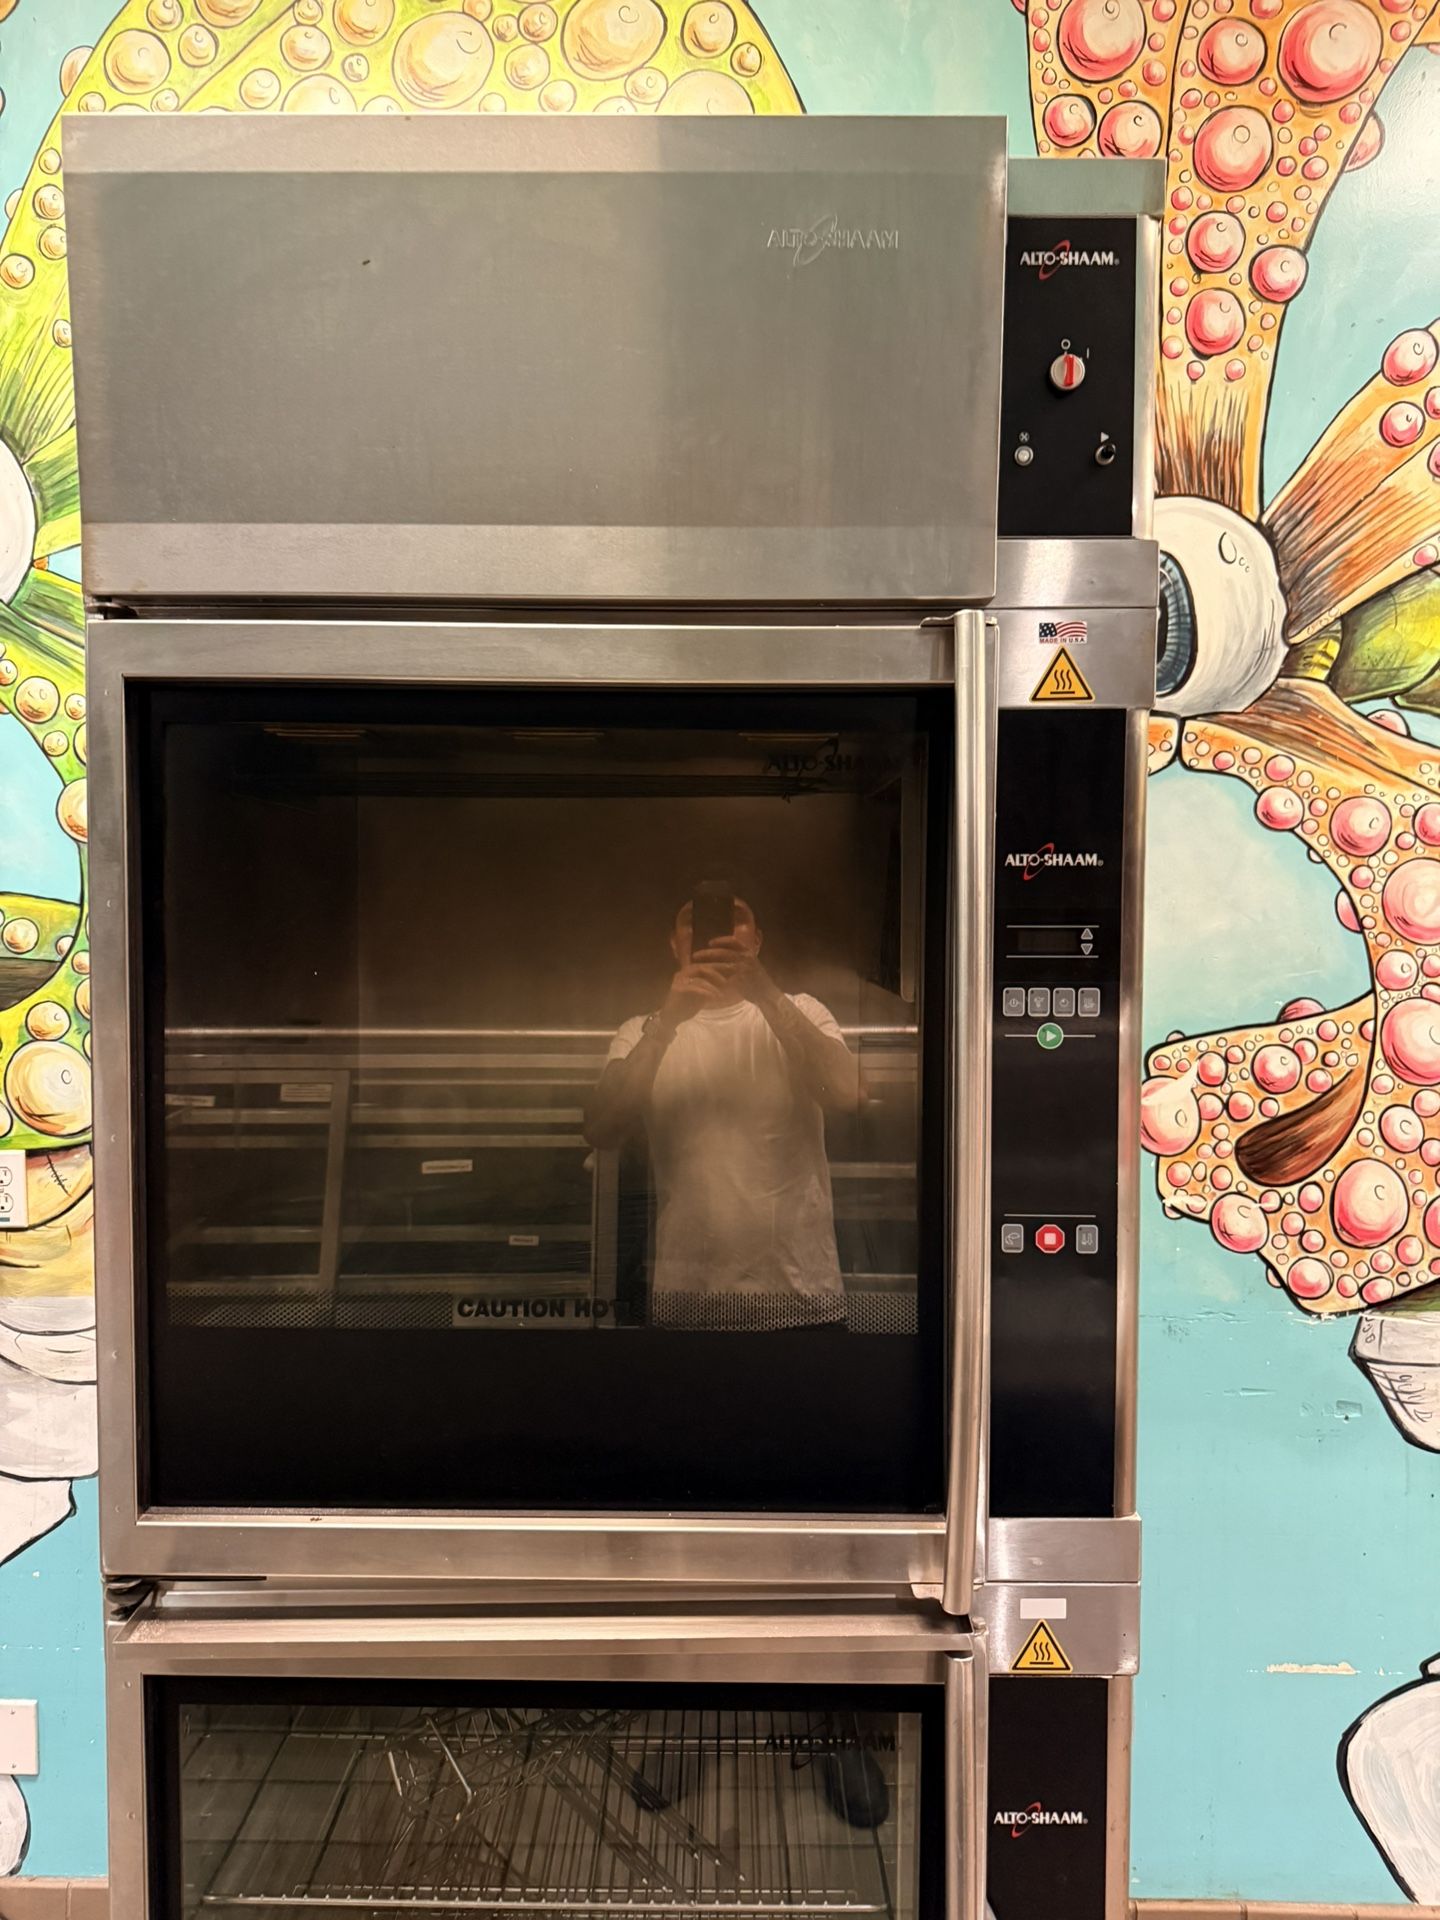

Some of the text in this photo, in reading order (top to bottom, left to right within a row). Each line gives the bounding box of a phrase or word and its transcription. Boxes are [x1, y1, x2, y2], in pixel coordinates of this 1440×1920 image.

[767, 229, 899, 249] ALTO-SHAAM
[1020, 251, 1114, 266] ALTO-SHAAM
[1004, 853, 1098, 867] ALTO-SHAAM
[457, 1299, 566, 1318] CAUTION
[993, 1811, 1083, 1824] ALTO-SHAAM
